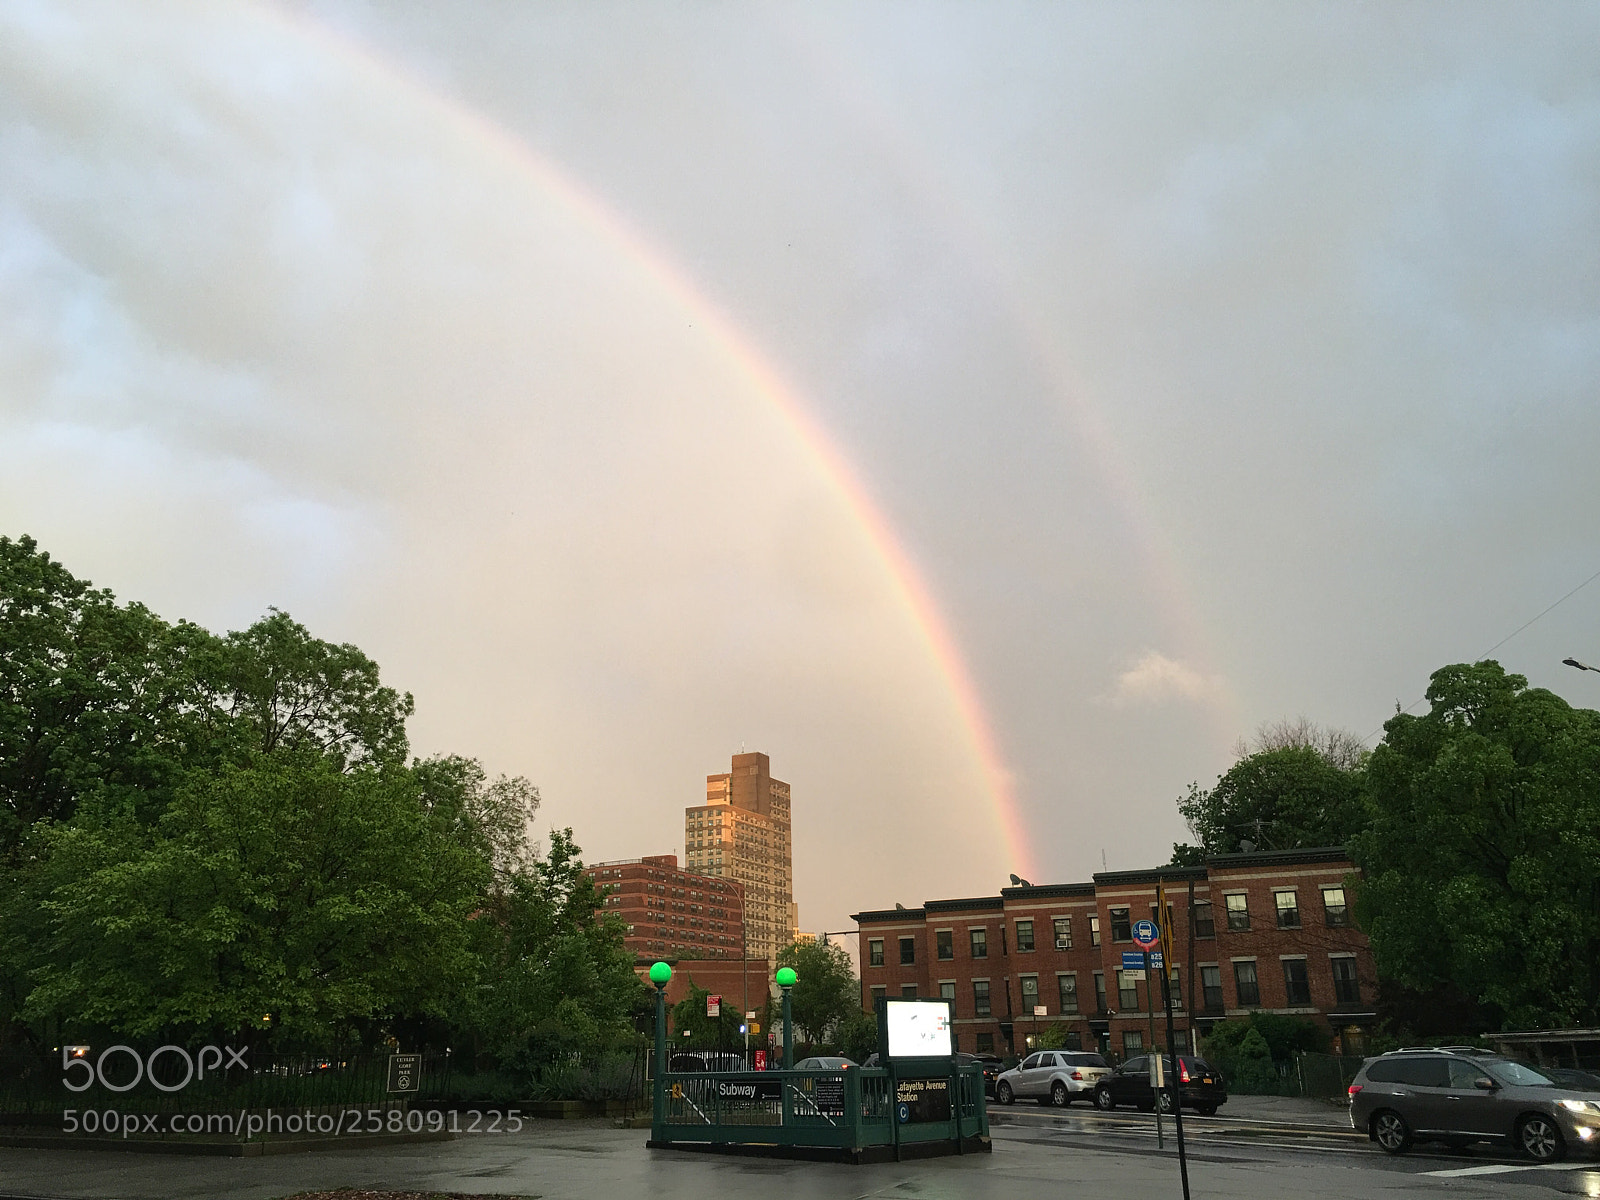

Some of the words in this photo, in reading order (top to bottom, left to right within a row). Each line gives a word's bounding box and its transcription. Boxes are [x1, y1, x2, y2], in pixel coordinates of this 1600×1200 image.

[926, 1080, 946, 1090] Avenue
[719, 1083, 756, 1099] Subway
[897, 1092, 918, 1102] Station
[900, 1106, 906, 1119] C
